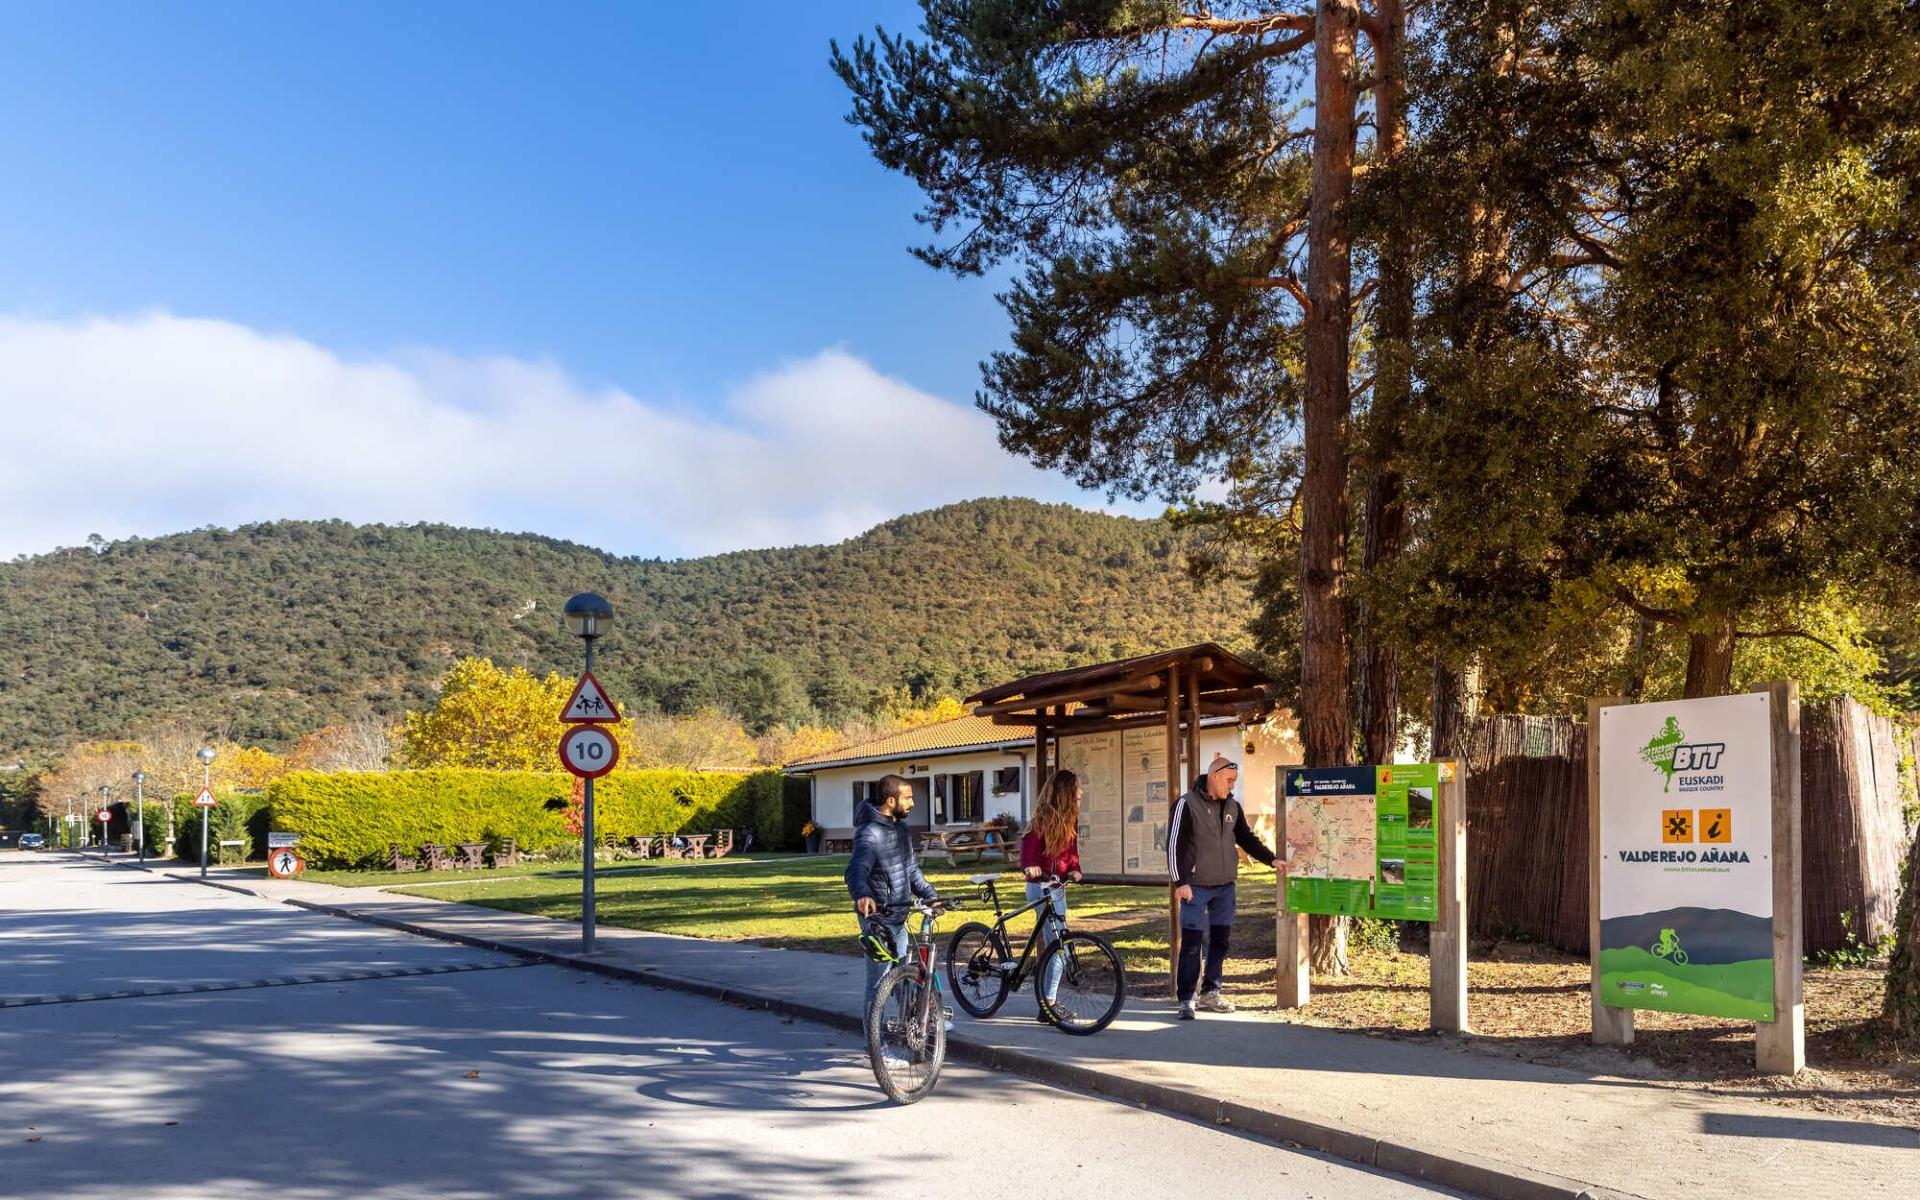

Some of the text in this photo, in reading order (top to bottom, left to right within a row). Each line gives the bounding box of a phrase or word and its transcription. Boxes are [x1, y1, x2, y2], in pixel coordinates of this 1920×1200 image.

[576, 742, 603, 760] 10
[1672, 743, 1725, 771] BTT
[1679, 775, 1724, 786] EUSKADI
[1619, 847, 1750, 863] VALDEREJO AÑANA
